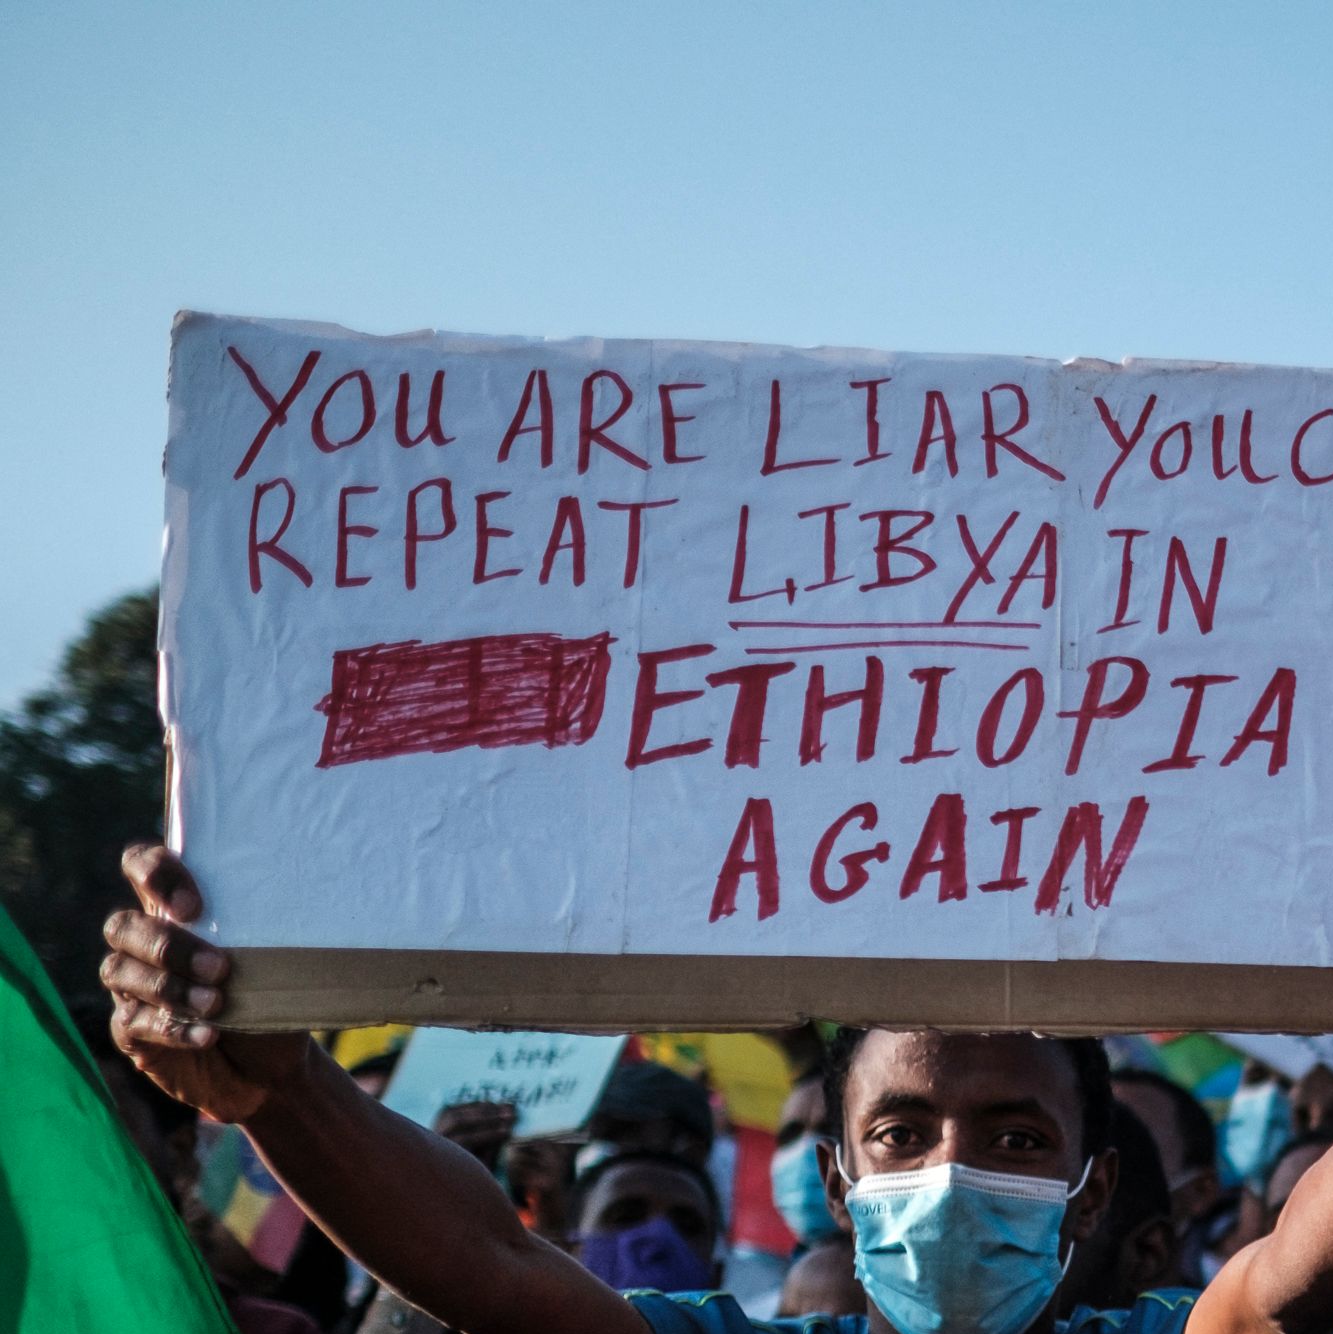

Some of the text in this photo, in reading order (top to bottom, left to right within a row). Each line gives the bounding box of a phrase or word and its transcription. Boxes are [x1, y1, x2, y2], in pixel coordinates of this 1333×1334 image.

[228, 347, 456, 480] YOU
[497, 368, 707, 474] ARE
[760, 376, 1067, 482] LIAR
[248, 477, 1228, 635] REPEAT LIBYA IN
[624, 642, 1298, 777] ETHIOPIA
[708, 793, 1150, 923] AGAIN
